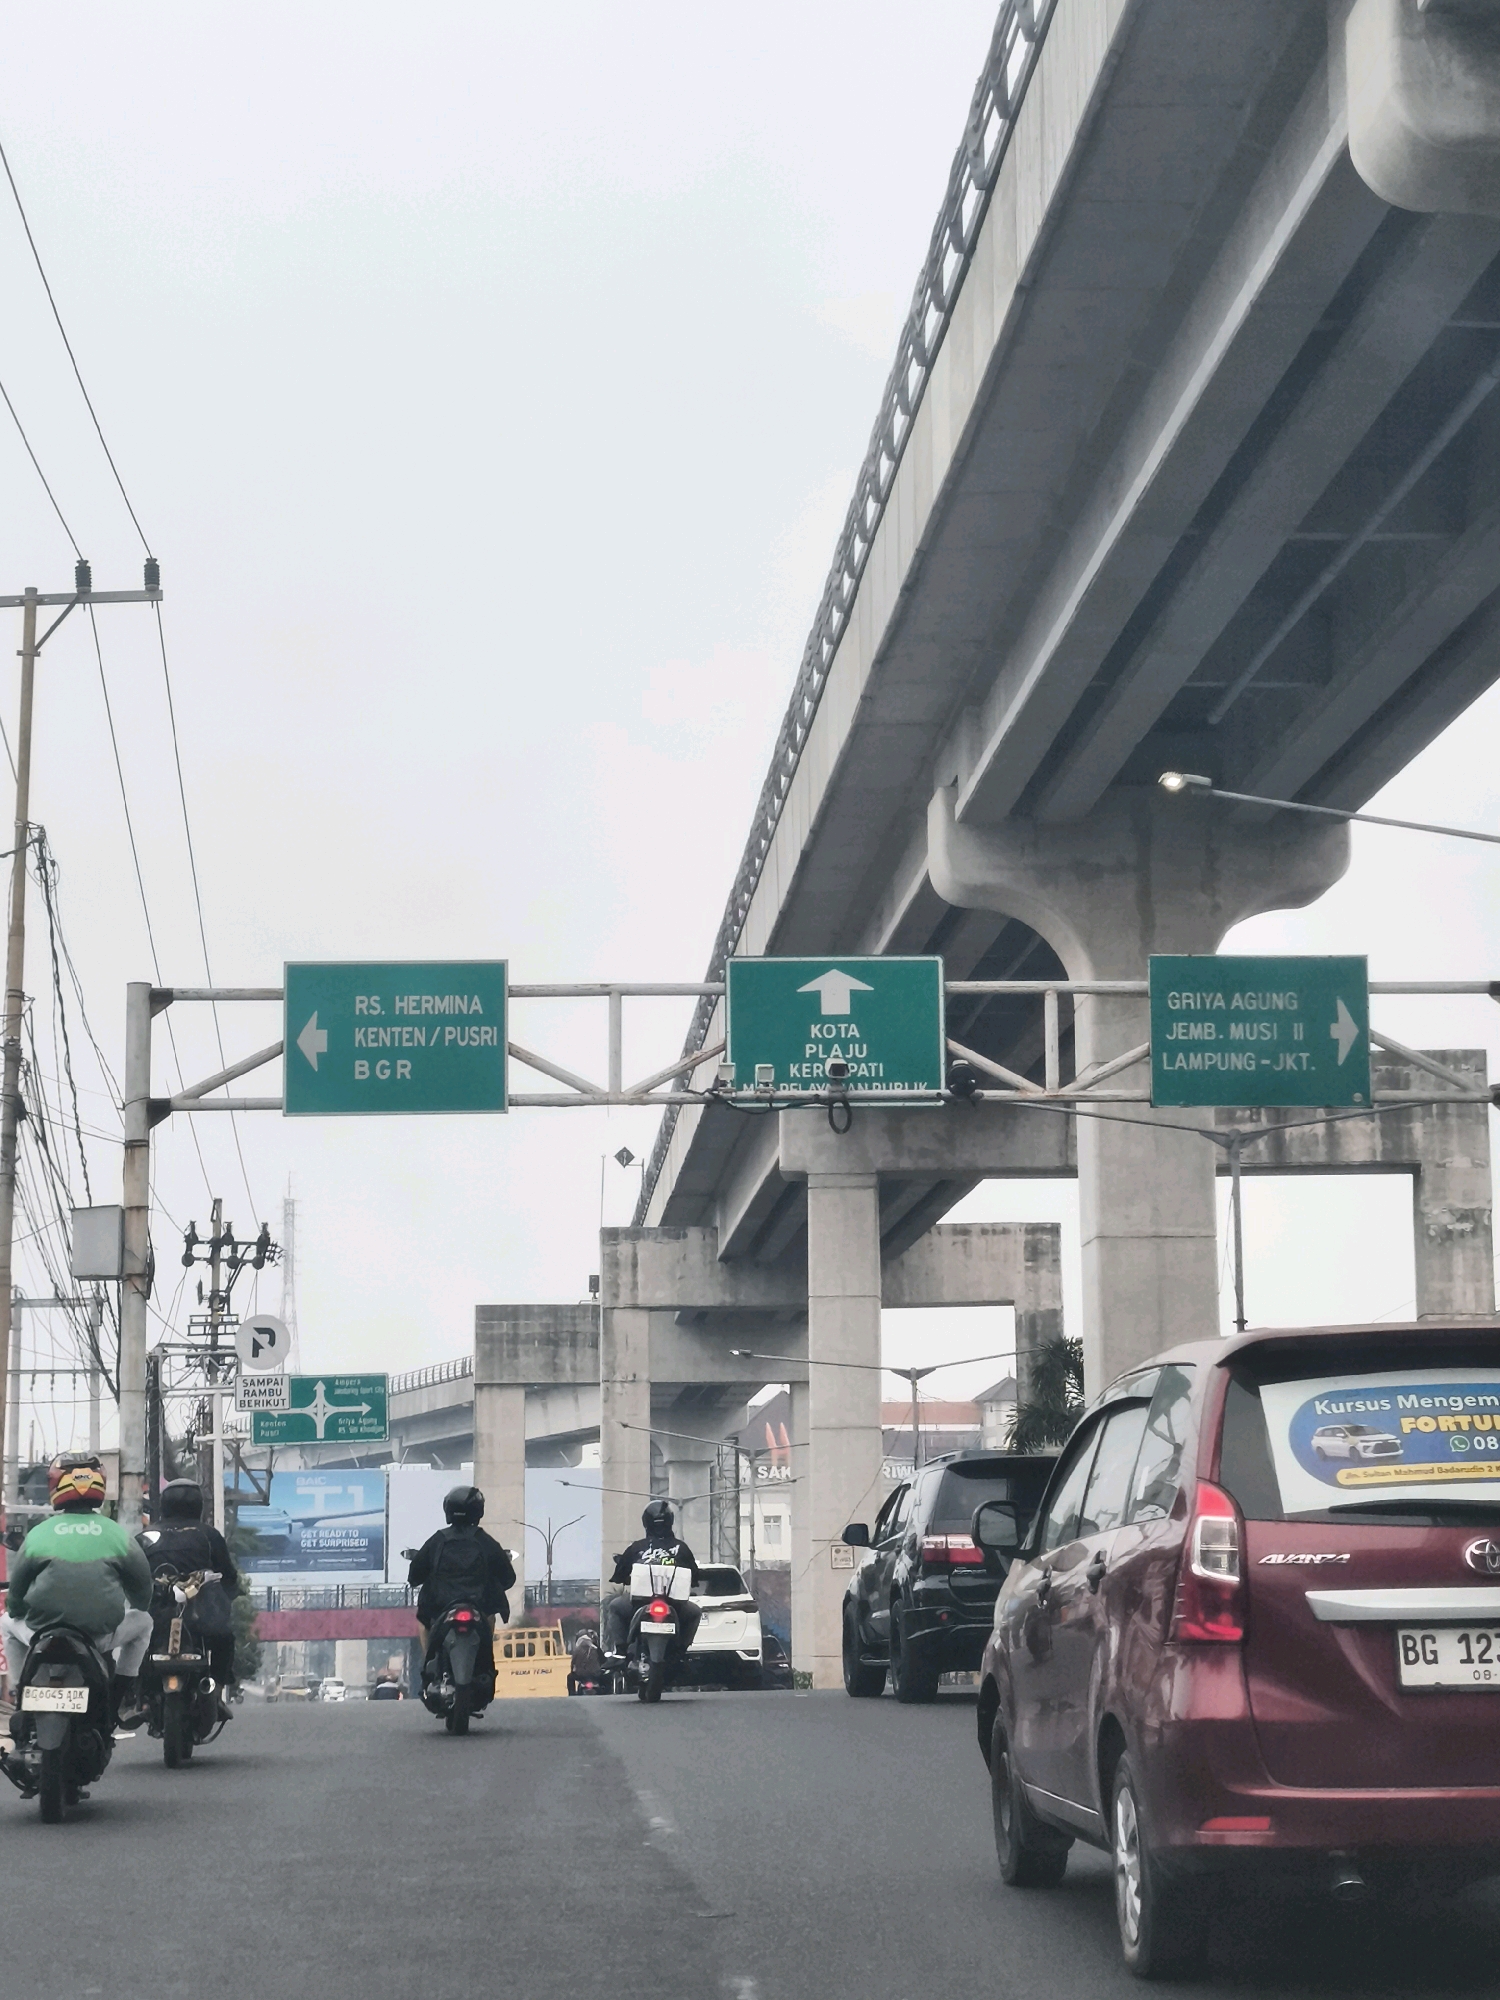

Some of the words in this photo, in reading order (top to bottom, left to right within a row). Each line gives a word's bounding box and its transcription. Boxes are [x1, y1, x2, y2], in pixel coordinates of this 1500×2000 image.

[355, 995, 385, 1015] RS.
[395, 994, 483, 1015] HERMINA
[1167, 991, 1226, 1010] GRIYA
[1230, 991, 1298, 1010] AGUNG
[810, 1024, 860, 1039] KOTA
[1166, 1022, 1224, 1040] JEMB.
[1229, 1022, 1278, 1040] MUSI
[805, 1043, 868, 1059] PLAJU
[354, 1059, 412, 1080] BGR
[789, 1063, 884, 1078] KERPATI
[242, 1378, 284, 1387] SAMPAI
[243, 1388, 282, 1398] RAMBU
[239, 1398, 286, 1408] BERIKUT
[1314, 1399, 1391, 1415] Kursus
[296, 1476, 326, 1486] BAIC
[1363, 1470, 1391, 1478] Sultan
[54, 1520, 102, 1536] Grab
[301, 1530, 317, 1539] GET
[319, 1529, 346, 1538] READY
[348, 1529, 359, 1537] TO
[301, 1539, 317, 1548] GET
[319, 1538, 369, 1548] SURPRISED!
[1258, 1553, 1350, 1564] AVANZA
[1402, 1634, 1439, 1665] BG
